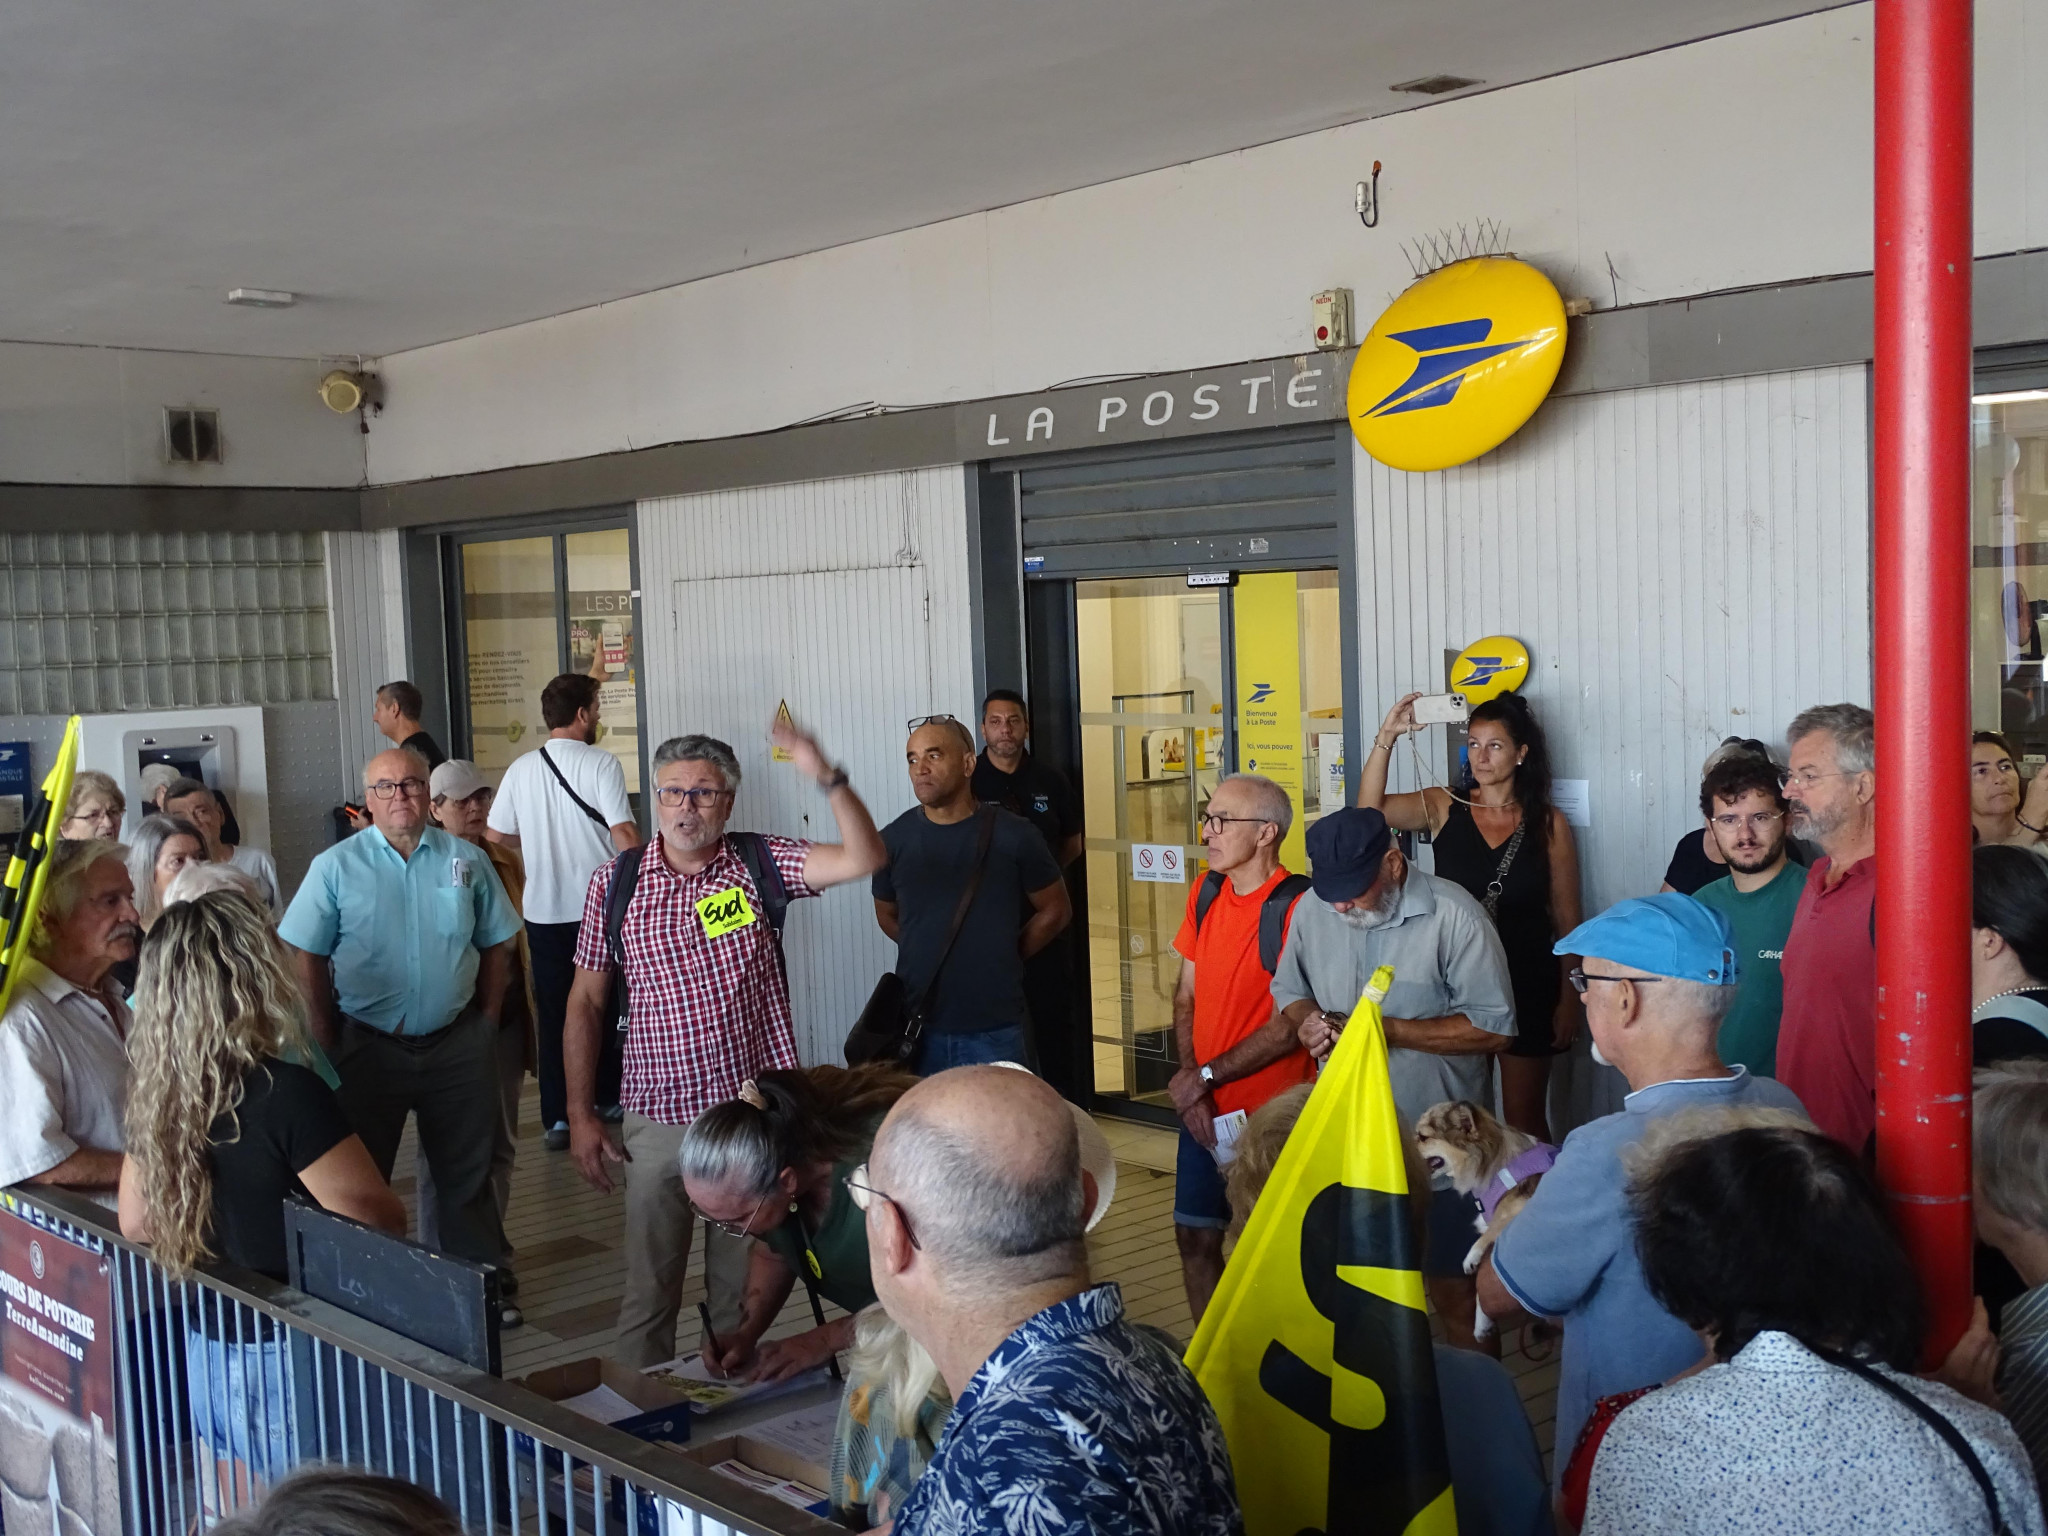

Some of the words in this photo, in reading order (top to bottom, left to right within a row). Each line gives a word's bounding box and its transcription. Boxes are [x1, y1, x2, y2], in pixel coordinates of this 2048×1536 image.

[1316, 297, 1332, 305] NEON
[987, 406, 1055, 446] LA
[1097, 369, 1322, 432] POSTE
[586, 595, 614, 612] LES
[482, 650, 522, 658] RENDEZ-VOUS
[704, 891, 745, 925] Sud
[1758, 949, 1784, 960] CARHA
[27, 1285, 43, 1314] DE
[44, 1294, 95, 1342] POTERIE
[5, 1300, 84, 1362] TerreAmandine
